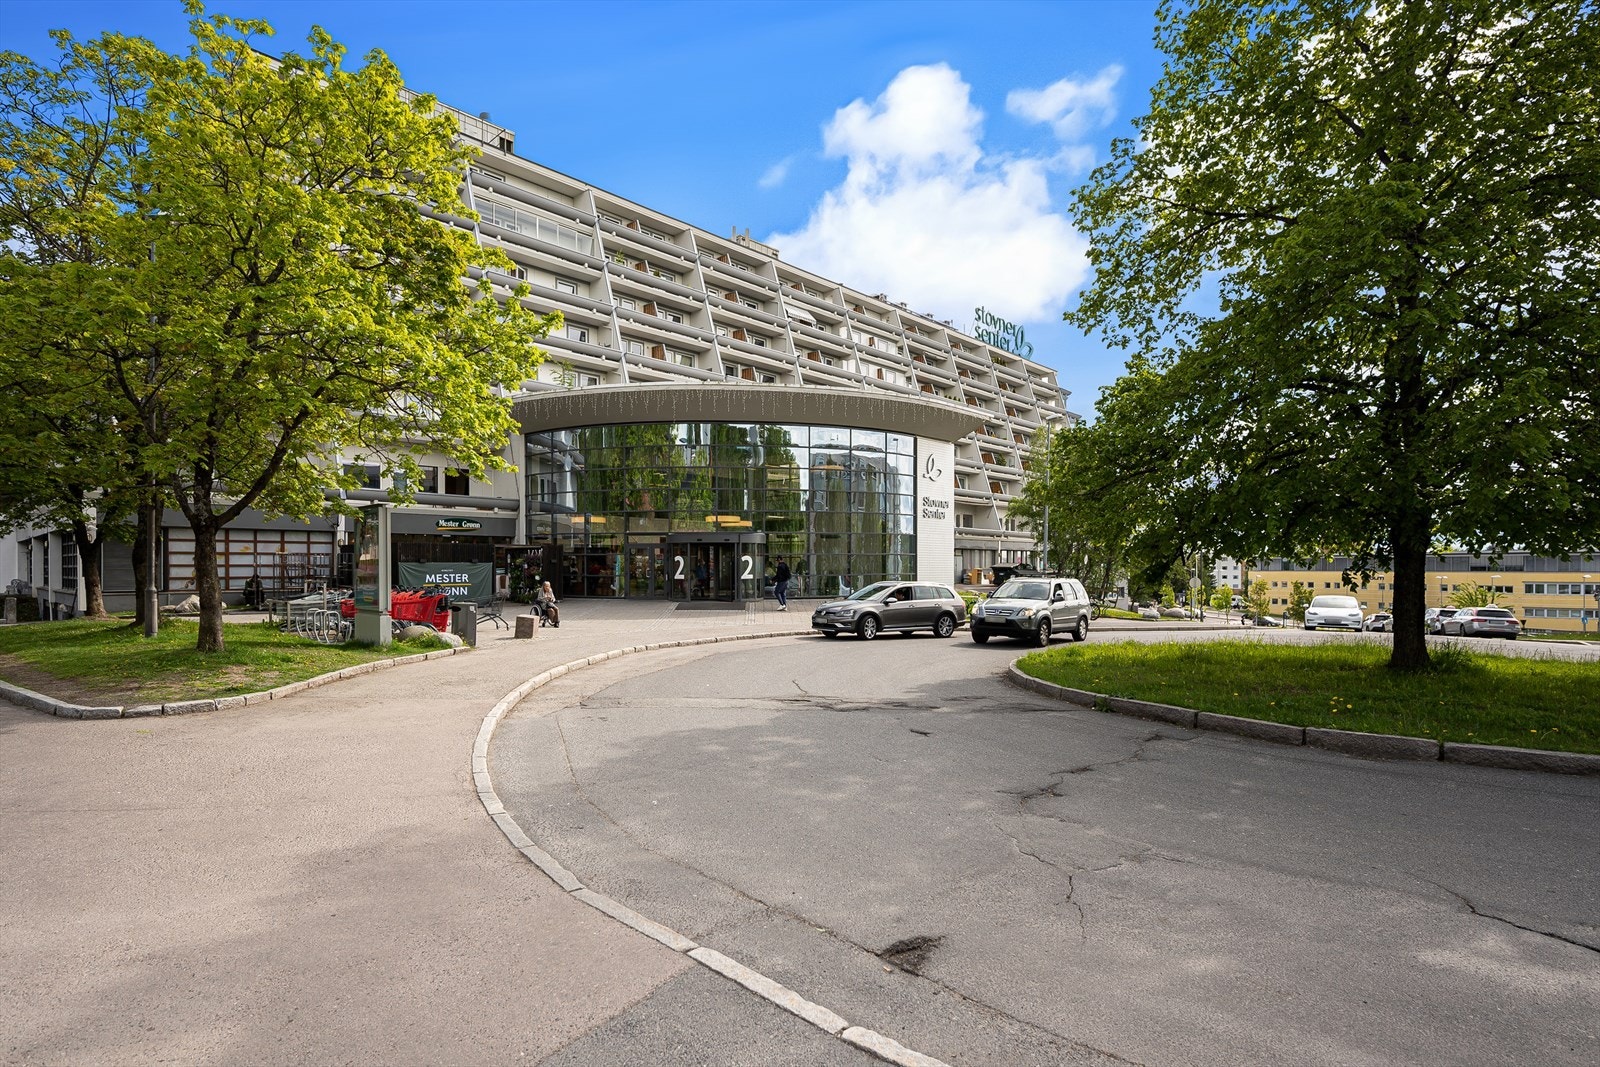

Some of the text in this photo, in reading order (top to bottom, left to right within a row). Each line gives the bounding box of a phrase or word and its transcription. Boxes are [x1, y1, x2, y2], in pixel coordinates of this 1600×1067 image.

[974, 305, 1018, 337] stovner
[438, 519, 459, 527] Mester
[425, 573, 469, 583] MESTER
[674, 555, 685, 579] 2
[740, 555, 754, 579] 2
